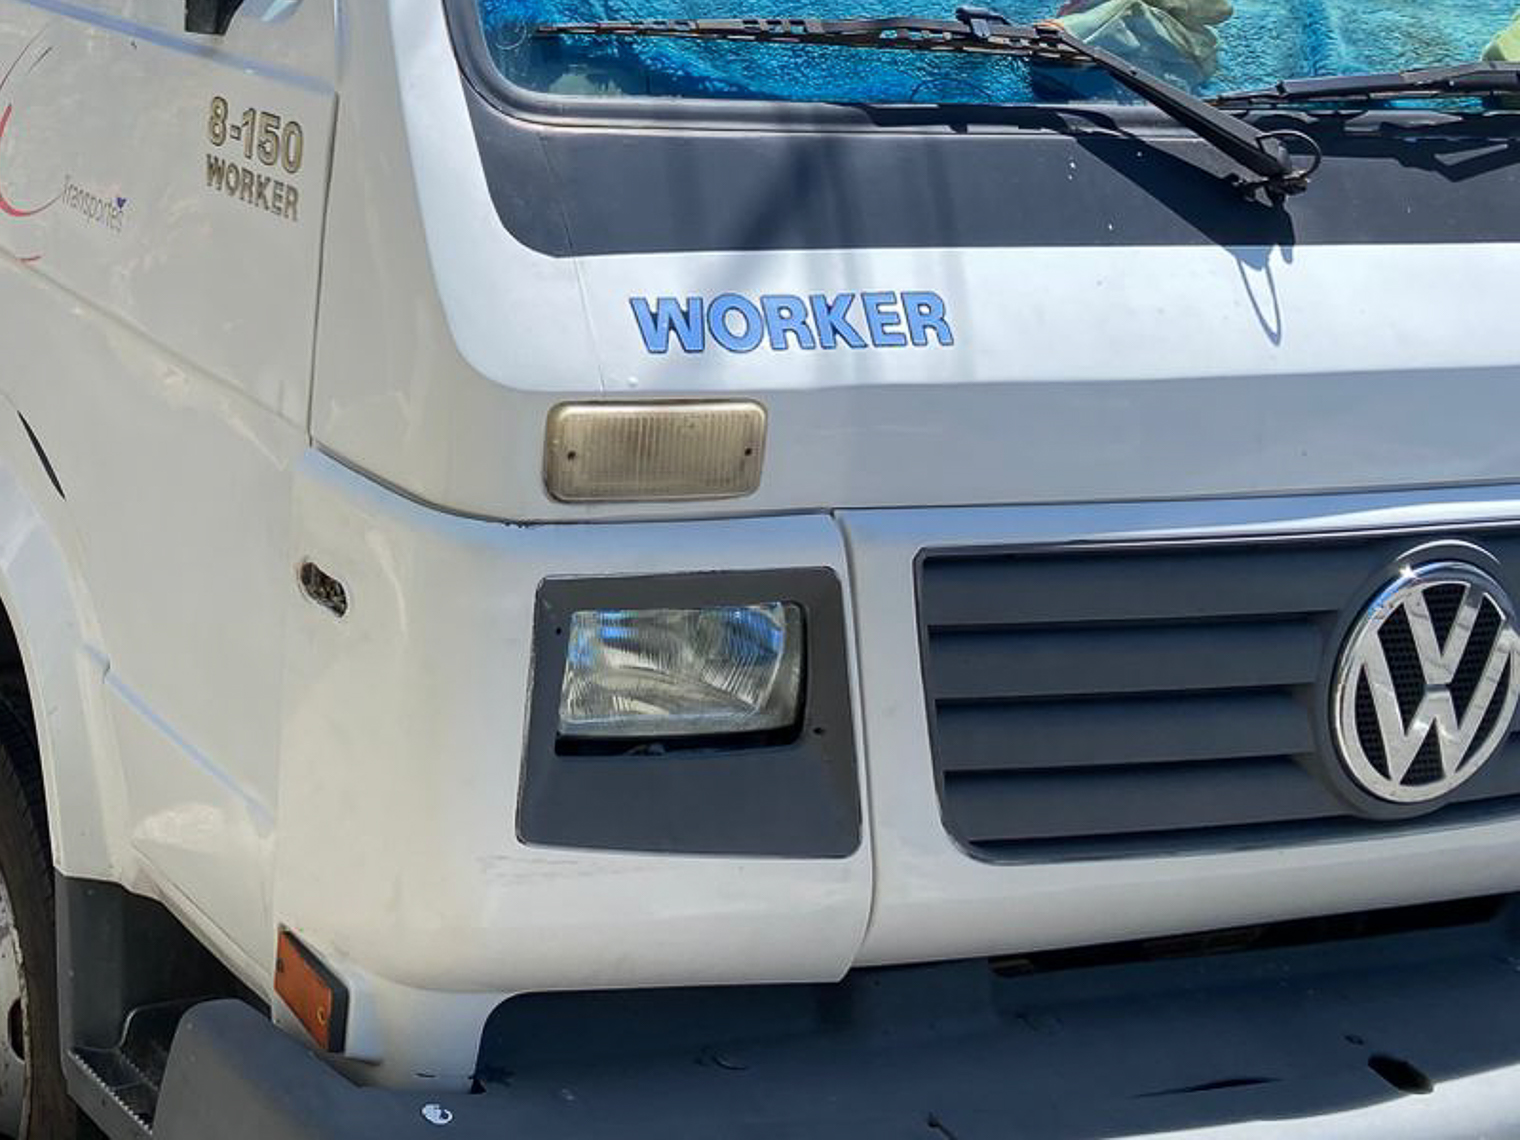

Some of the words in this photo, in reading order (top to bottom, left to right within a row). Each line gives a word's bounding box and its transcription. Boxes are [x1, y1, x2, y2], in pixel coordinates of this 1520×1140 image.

[209, 96, 304, 174] 8-150
[206, 153, 299, 221] WORKER
[629, 290, 955, 354] WORKER
